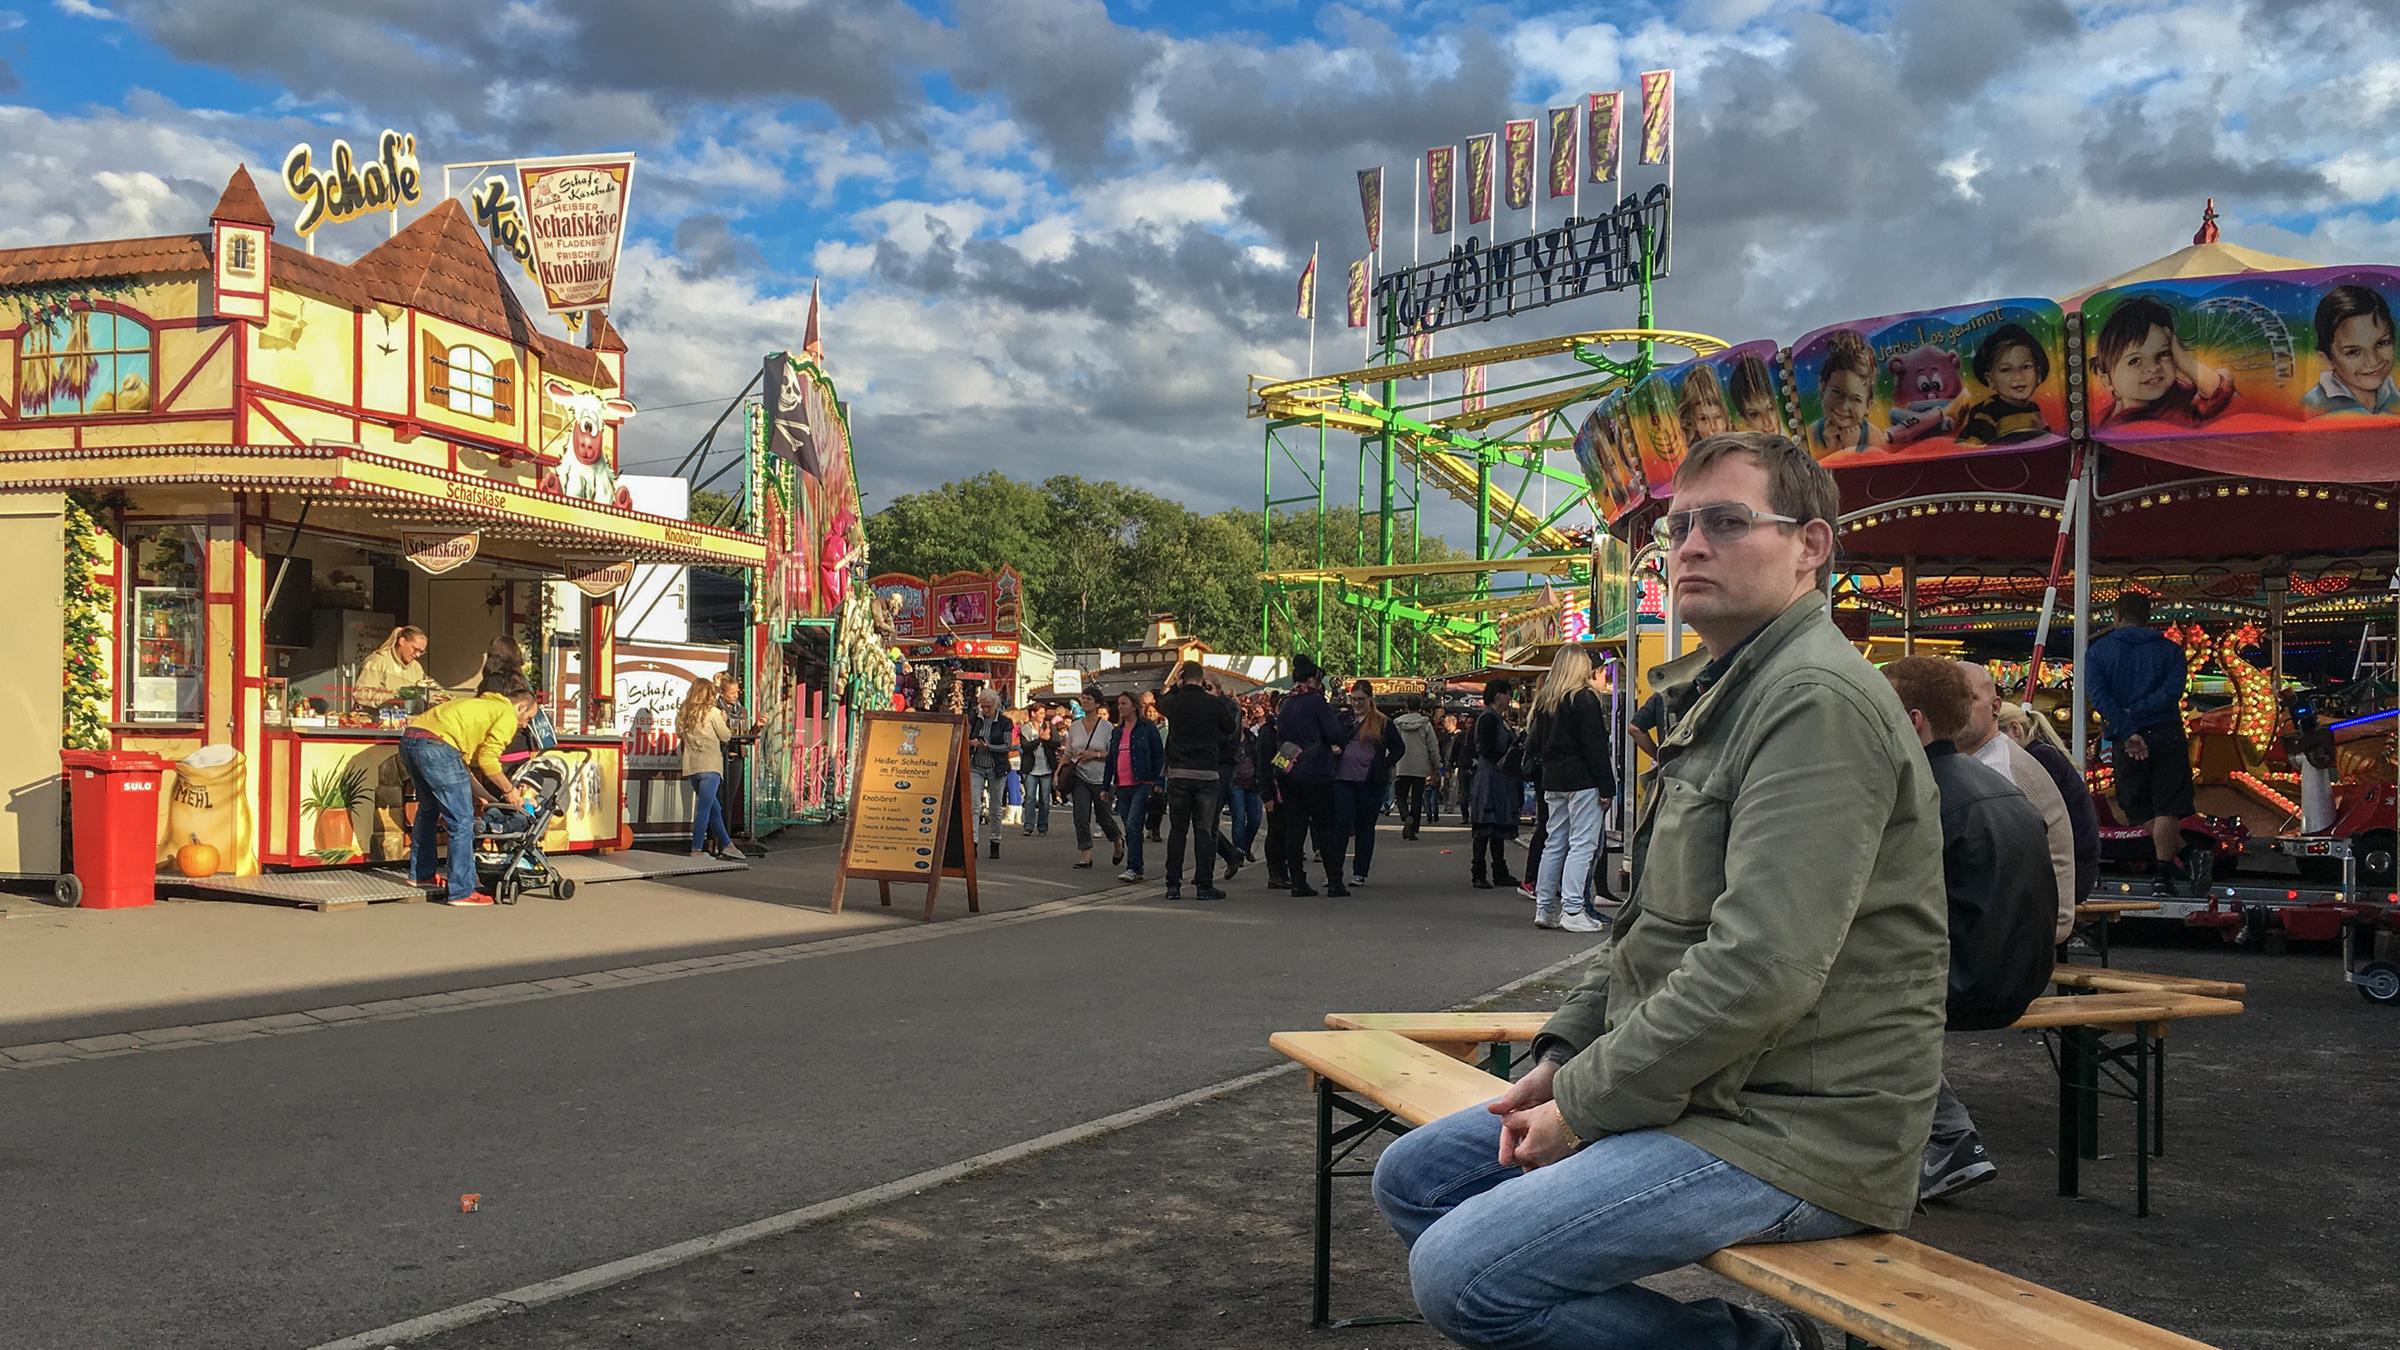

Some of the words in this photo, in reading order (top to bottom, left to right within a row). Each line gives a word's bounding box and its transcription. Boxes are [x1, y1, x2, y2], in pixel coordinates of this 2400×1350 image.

[554, 203, 598, 214] HEISSER
[534, 210, 617, 239] Schafskäse
[557, 237, 609, 248] FLADENBROT
[557, 251, 600, 261] FRISCHES
[541, 259, 613, 284] Knobibrot
[1918, 326, 1945, 346] Los
[1948, 305, 2005, 344] gewinnt
[446, 482, 506, 509] Schafskäse
[664, 526, 703, 547] Knobibrot
[408, 538, 470, 558] Schafskäse
[569, 566, 627, 582] Knobibrot
[623, 715, 672, 726] FRISCHES
[874, 757, 899, 765] Heißer
[890, 768, 930, 776] Fladenbrot
[123, 782, 153, 791] SULO
[174, 785, 213, 809] MEHL
